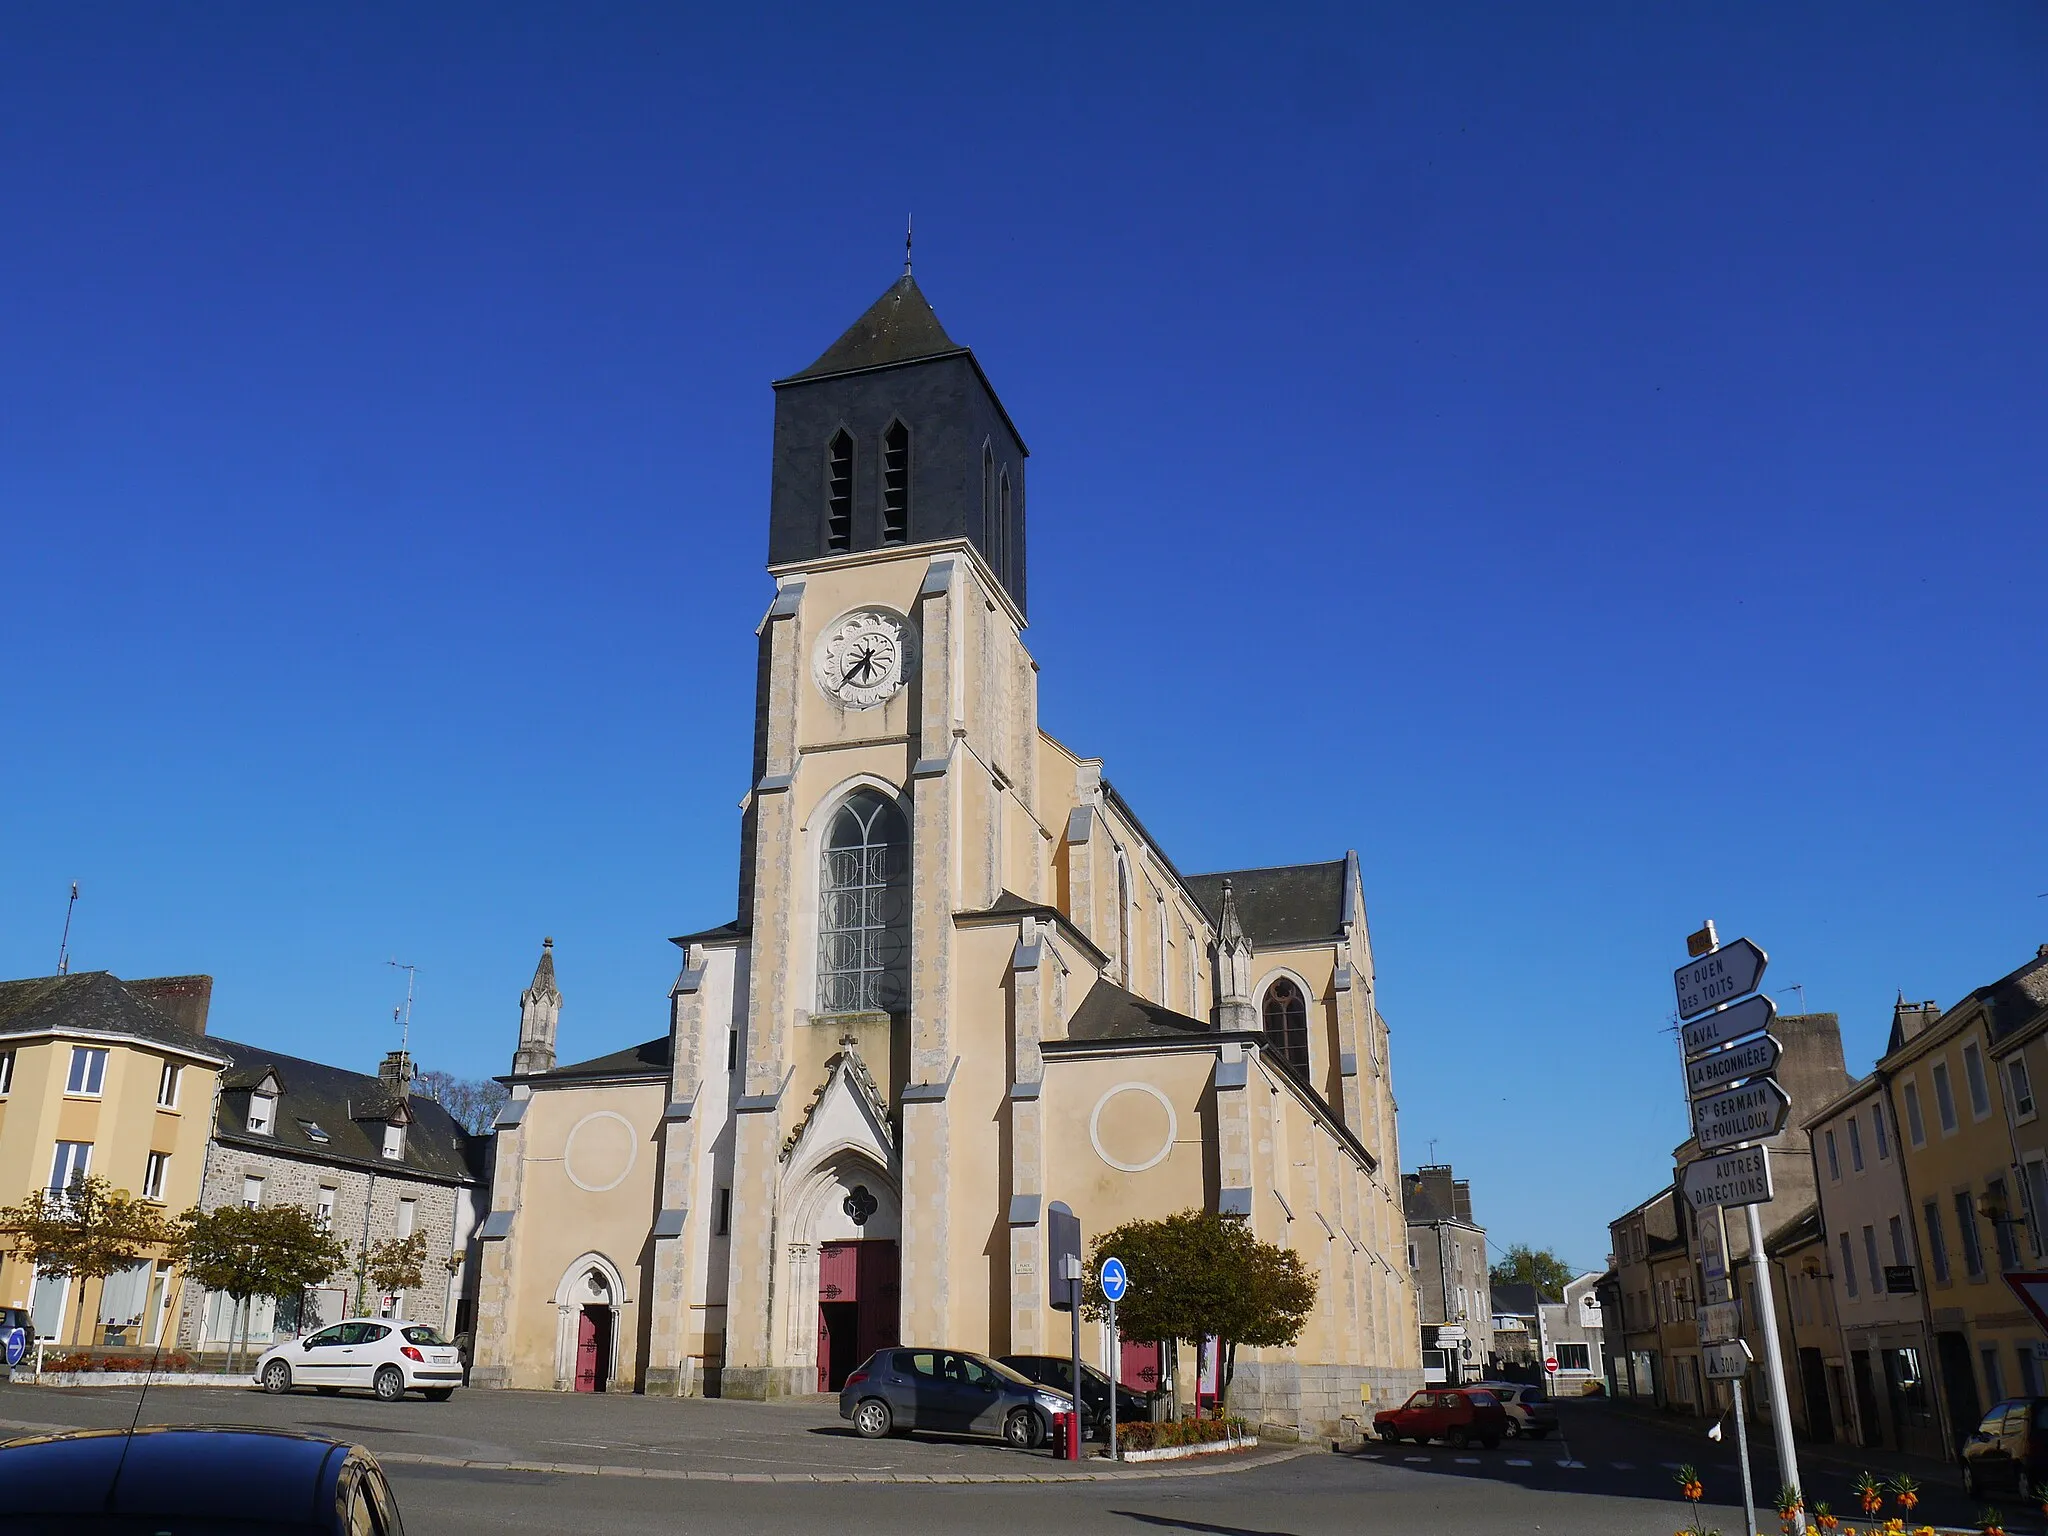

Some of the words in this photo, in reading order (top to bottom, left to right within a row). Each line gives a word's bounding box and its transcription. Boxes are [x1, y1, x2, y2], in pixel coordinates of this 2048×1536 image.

[1694, 959, 1724, 983] OUEN
[1682, 994, 1699, 1010] DES
[1702, 976, 1734, 1000] TOITS
[1686, 1023, 1719, 1046] LAVAL
[1692, 1068, 1704, 1084] LA
[1706, 1047, 1767, 1077] BACONNIÈRE
[1714, 1089, 1767, 1118] GERMAIN
[1701, 1129, 1711, 1142] LE
[1712, 1111, 1770, 1140] FOUILLOUX
[1716, 1155, 1761, 1179] AUTRES
[1695, 1178, 1764, 1205] DIRECTIONS
[1720, 1356, 1734, 1373] 300
